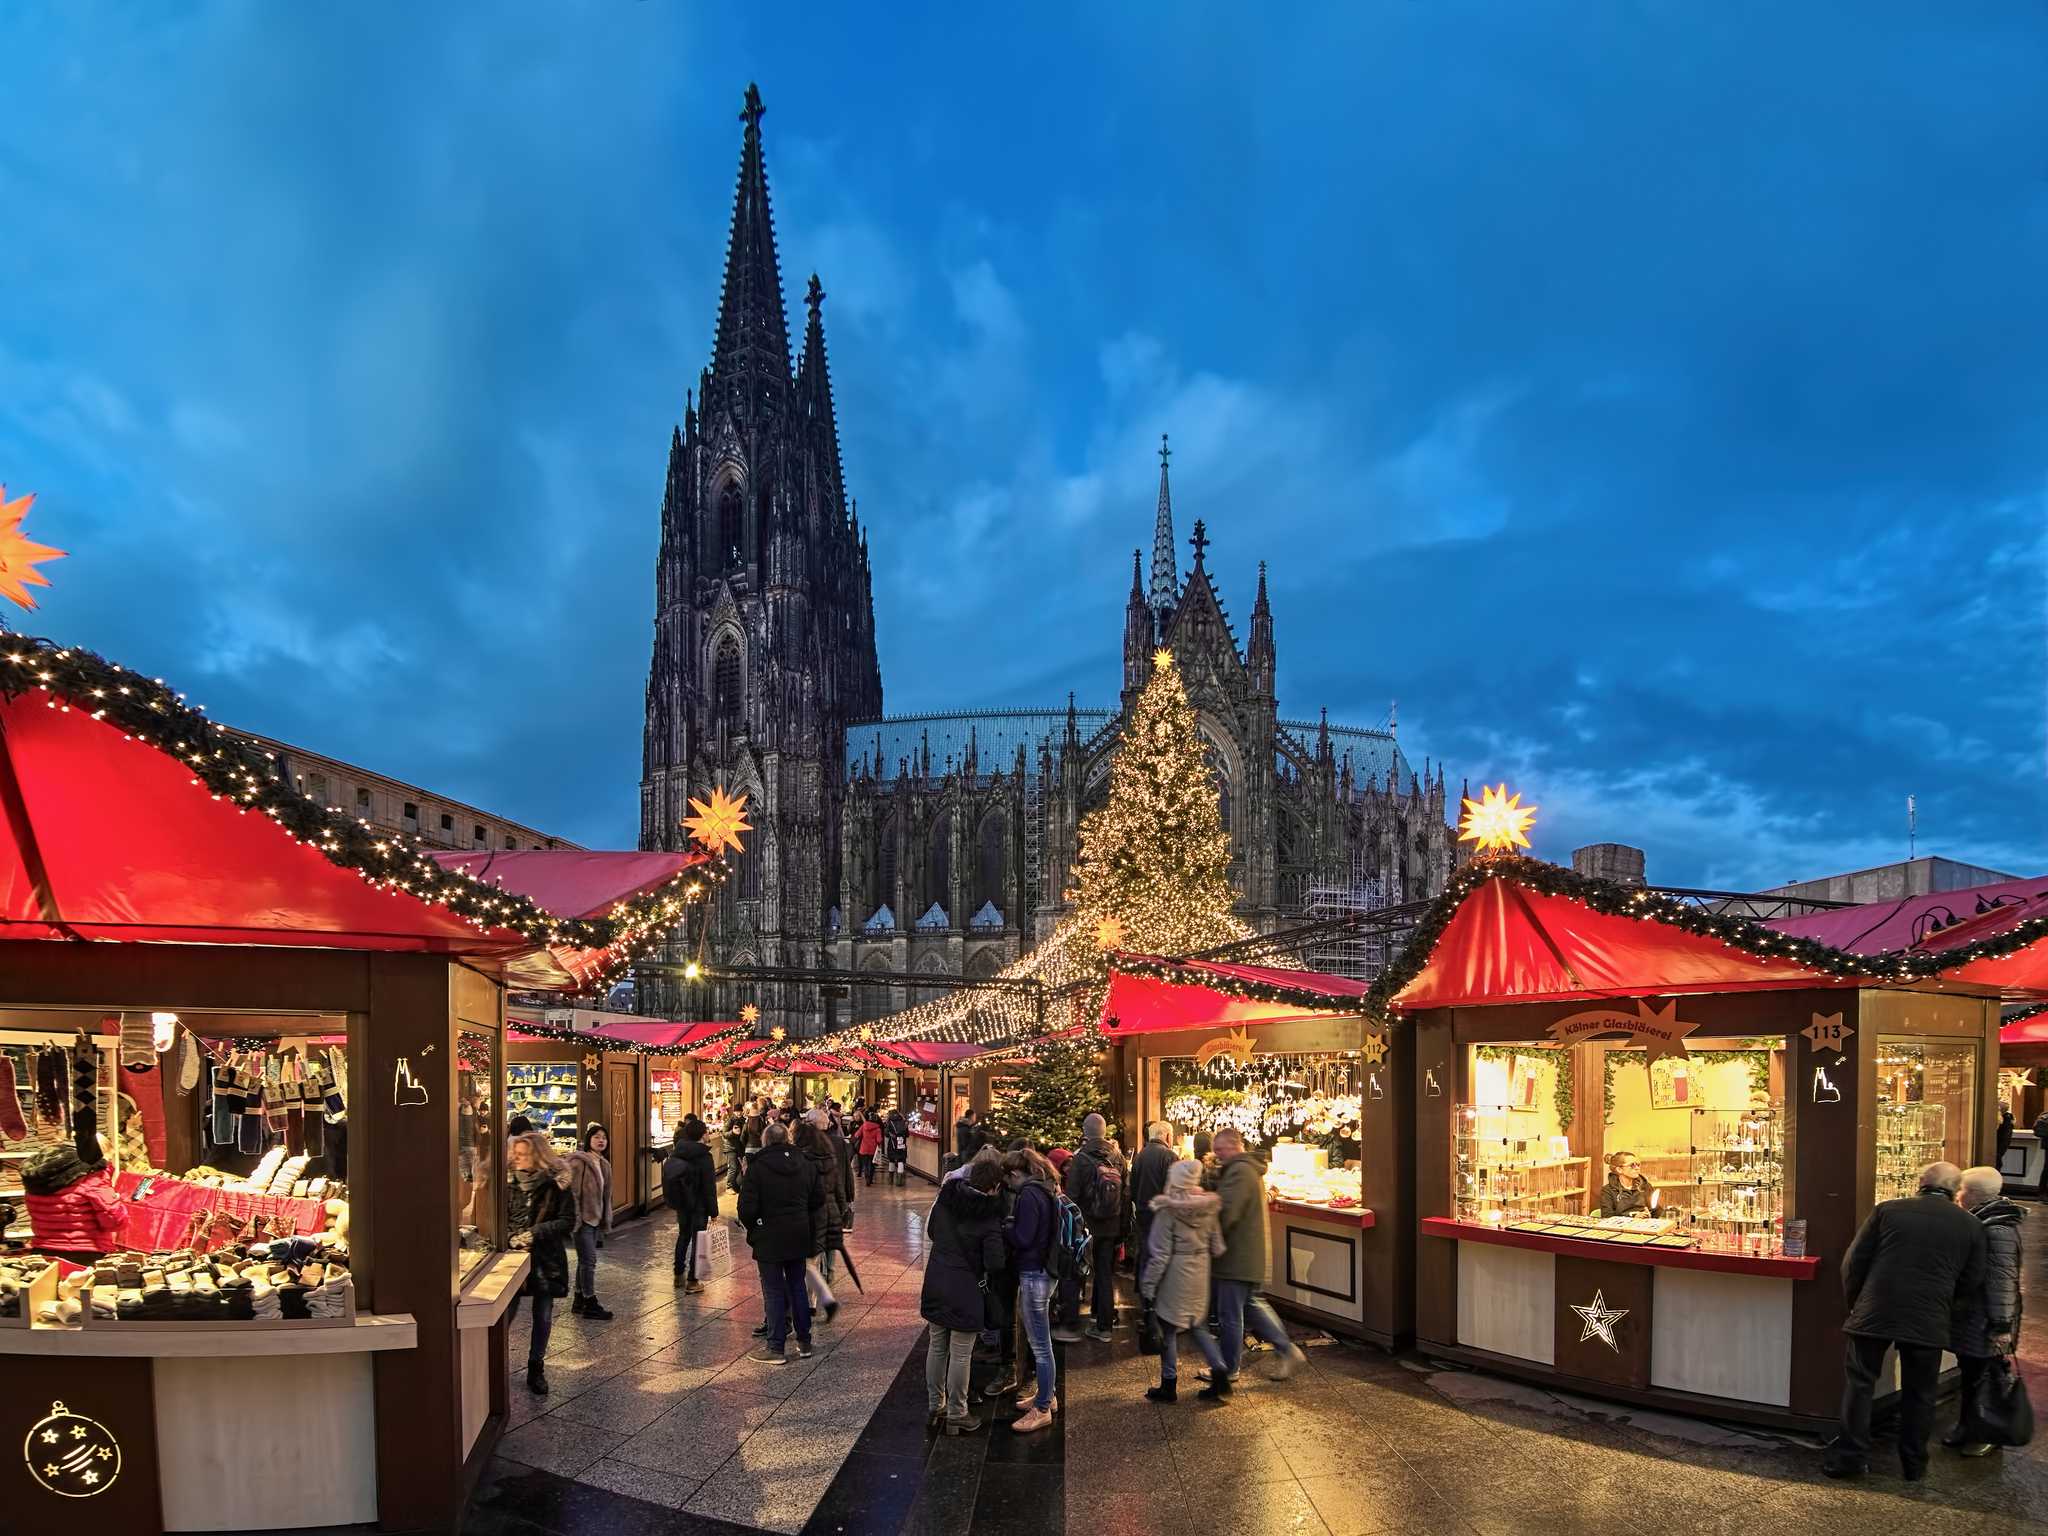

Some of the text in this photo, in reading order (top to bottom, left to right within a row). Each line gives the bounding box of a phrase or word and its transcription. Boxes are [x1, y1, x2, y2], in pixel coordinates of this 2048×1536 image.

[1565, 1019, 1672, 1041] Kölner Glasbläserei
[1813, 1025, 1840, 1039] 113
[1368, 1043, 1381, 1054] 112
